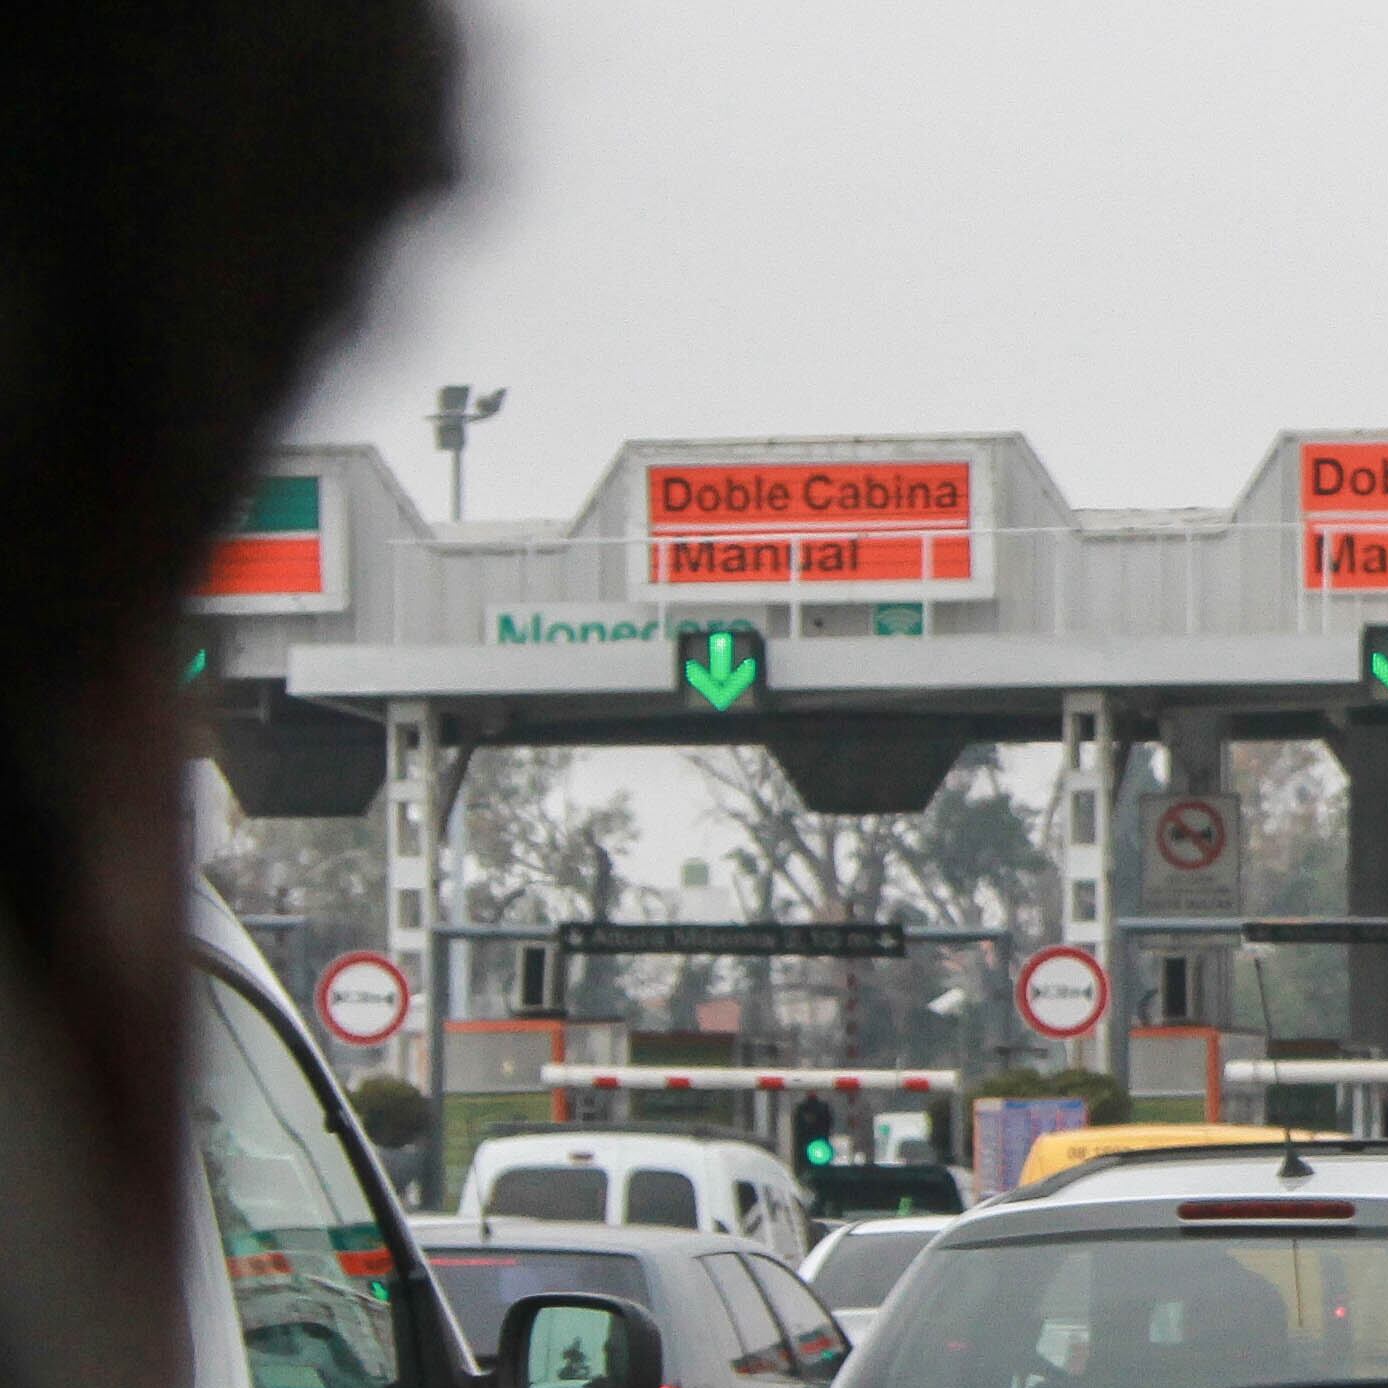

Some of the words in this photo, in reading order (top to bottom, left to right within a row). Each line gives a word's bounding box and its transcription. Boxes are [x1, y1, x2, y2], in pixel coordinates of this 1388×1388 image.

[663, 475, 791, 513] Doble
[804, 473, 960, 512] Cabina
[671, 538, 860, 574] Manual
